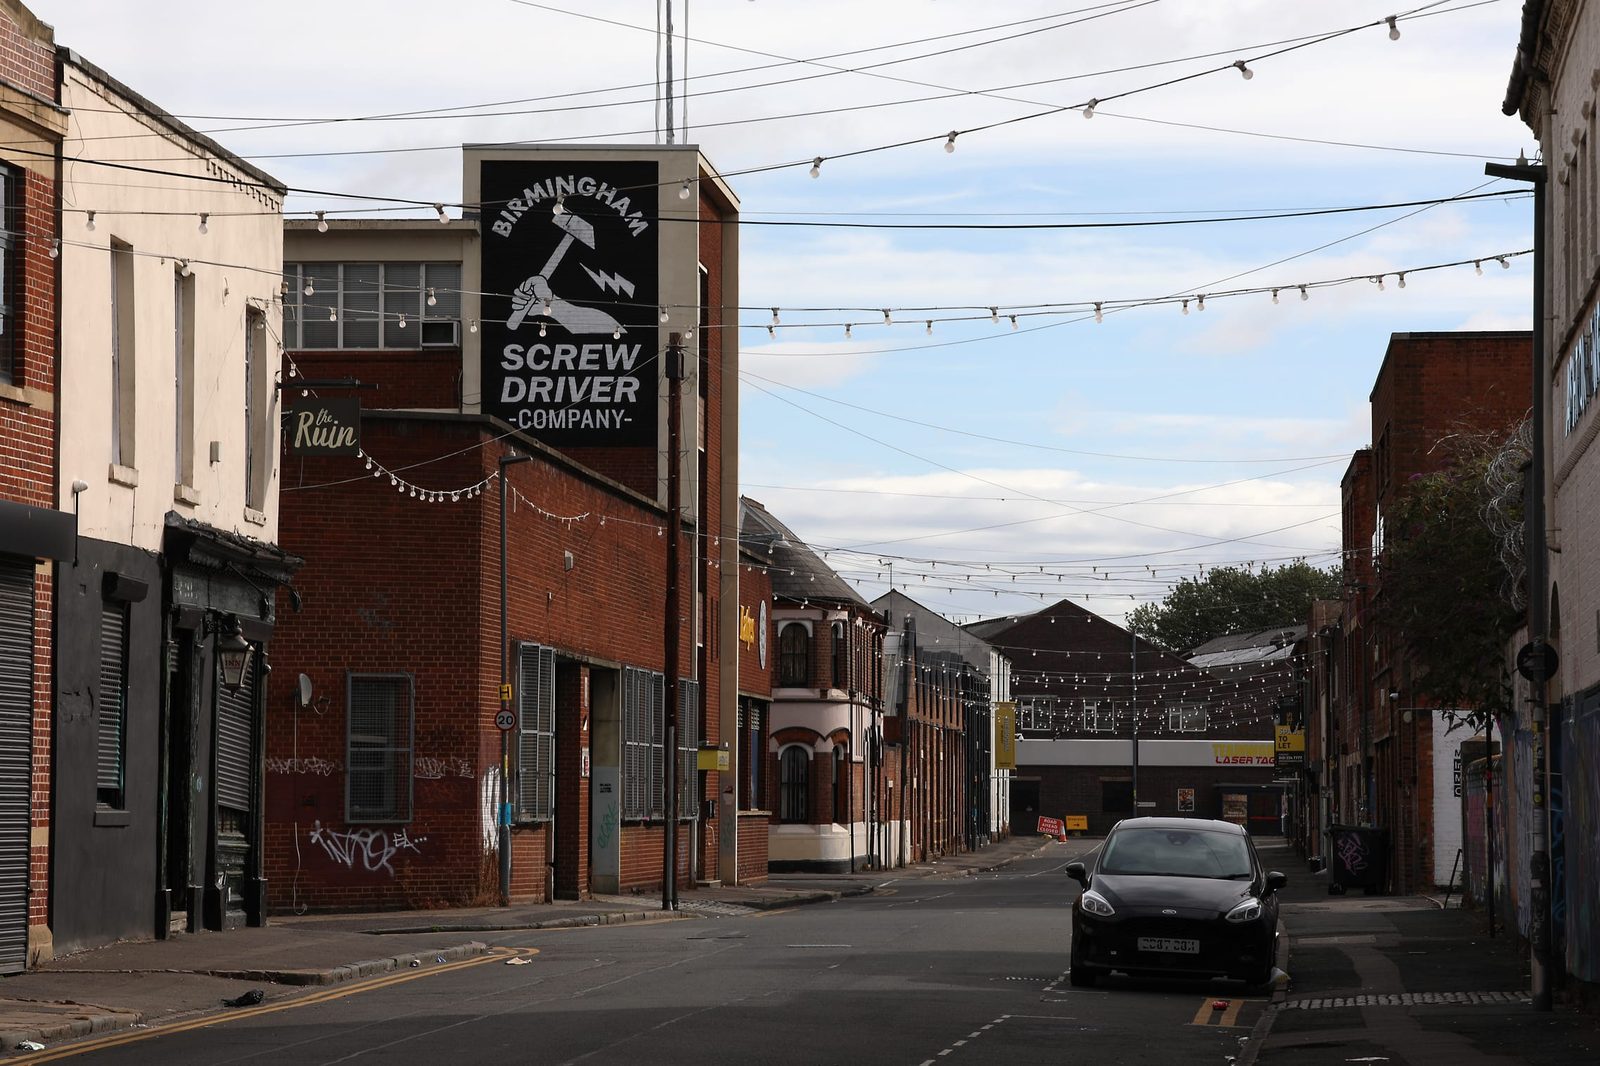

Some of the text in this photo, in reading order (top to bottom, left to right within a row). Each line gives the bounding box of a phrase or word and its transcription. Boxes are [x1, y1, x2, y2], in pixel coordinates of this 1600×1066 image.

[492, 175, 649, 238] BIRMINGHAM
[501, 344, 641, 371] SCREW
[501, 376, 640, 403] DRIVER
[316, 407, 333, 426] the
[294, 411, 357, 449] Ruin
[499, 685, 510, 698] H
[498, 715, 514, 725] 20
[1215, 756, 1253, 764] LASER
[1255, 756, 1275, 764] TAG
